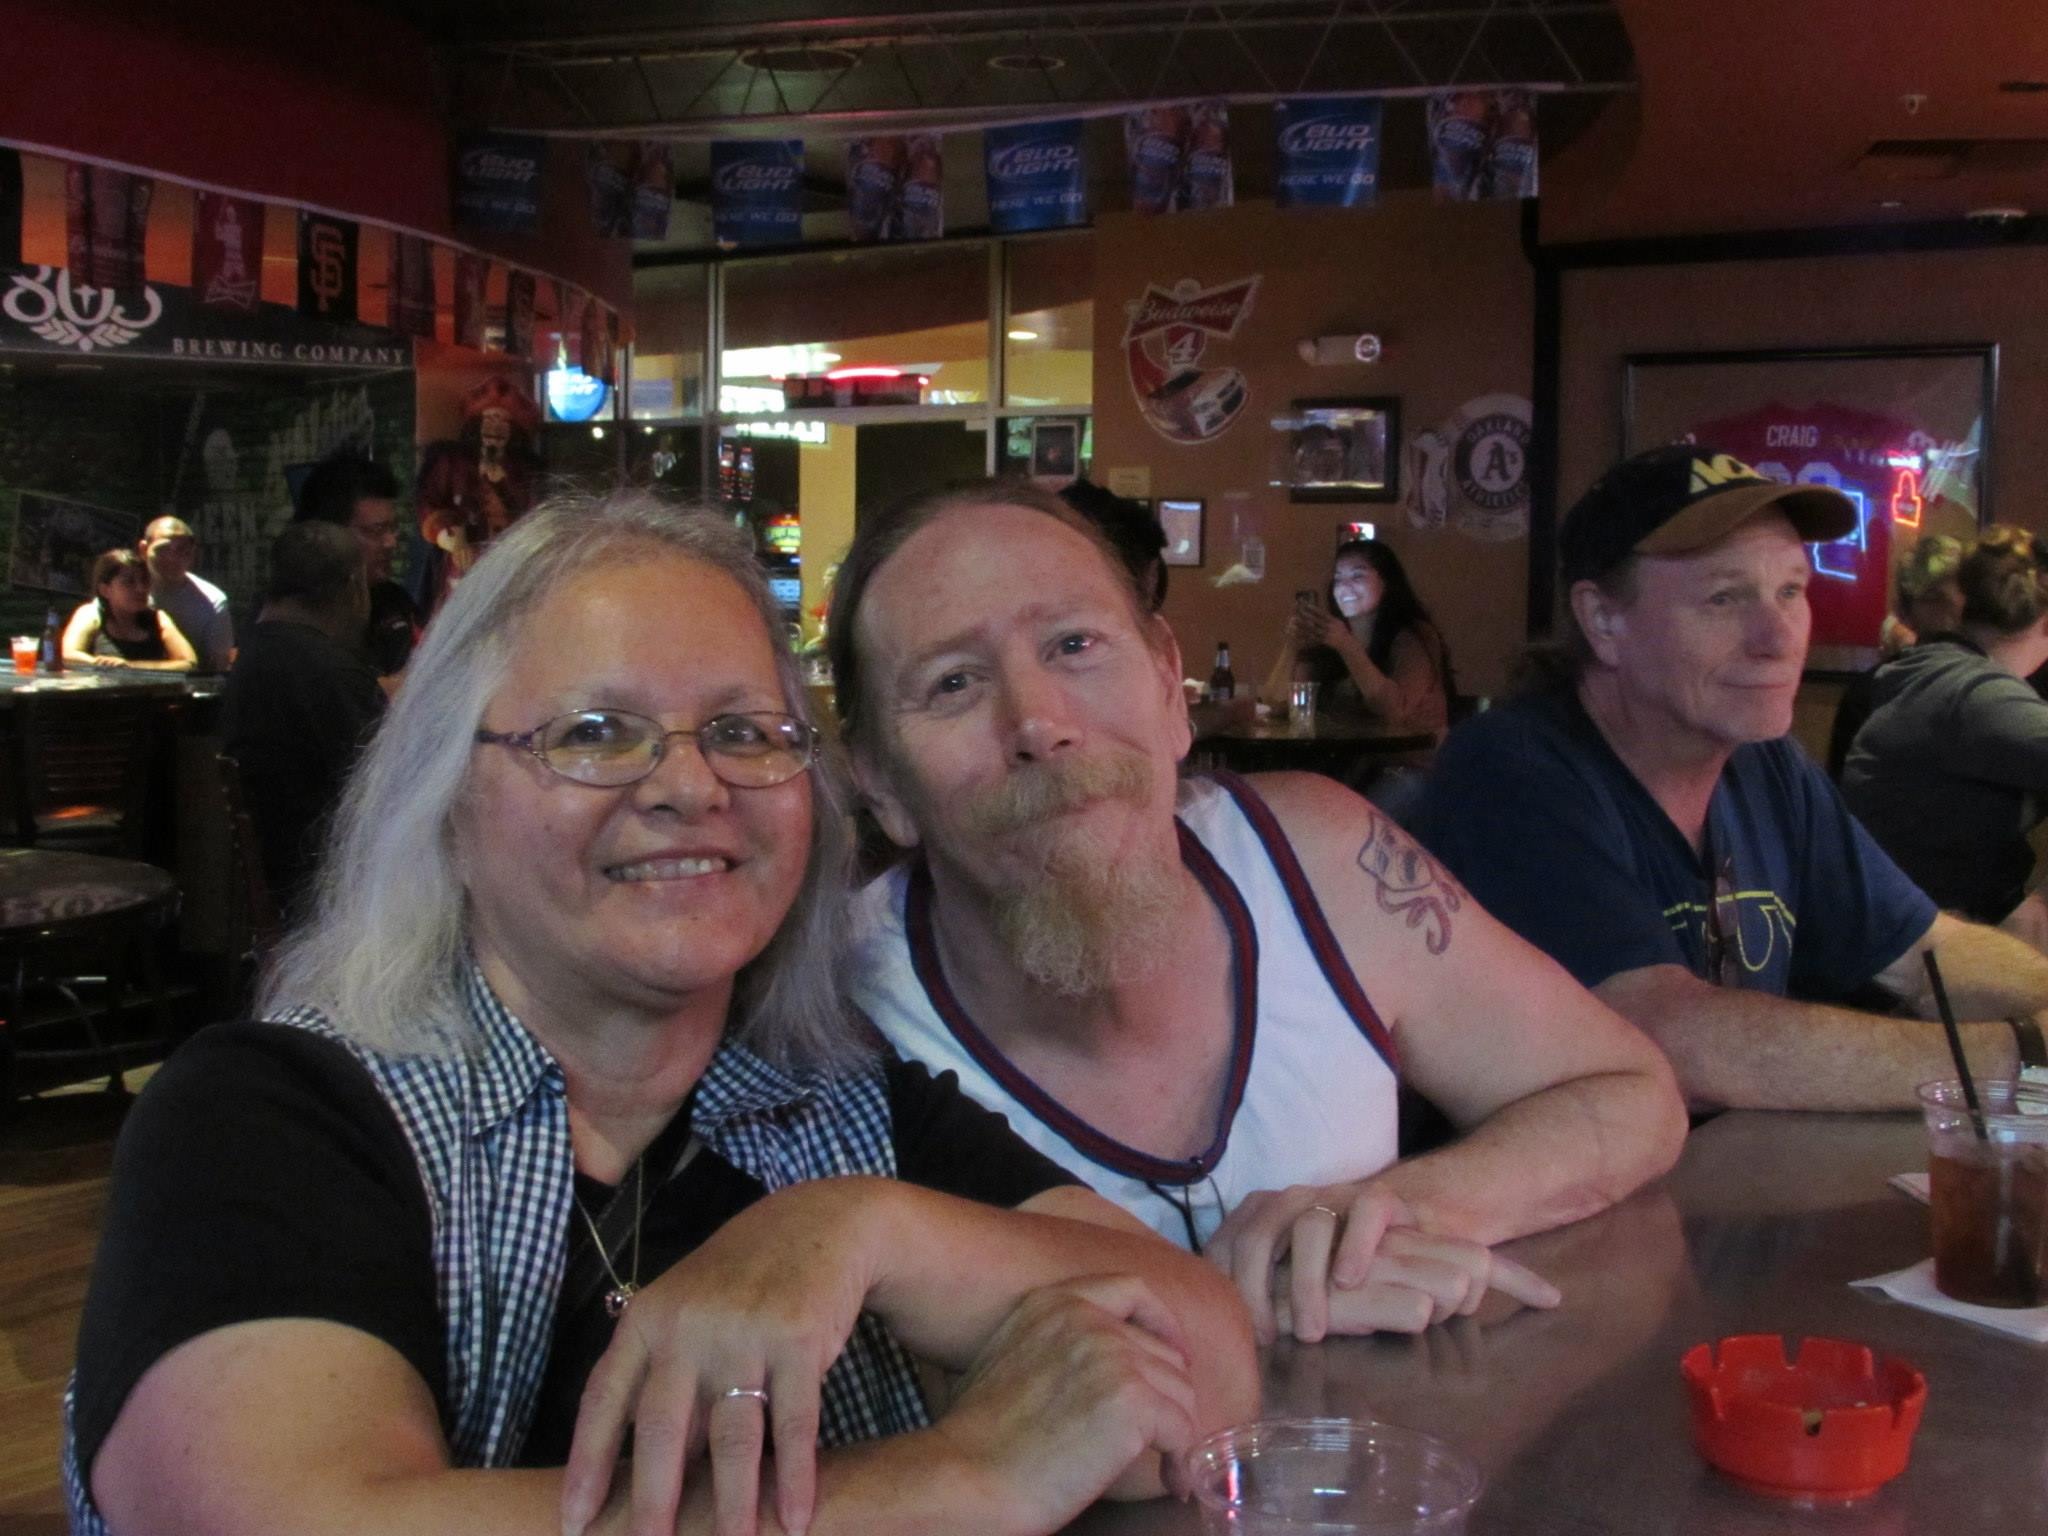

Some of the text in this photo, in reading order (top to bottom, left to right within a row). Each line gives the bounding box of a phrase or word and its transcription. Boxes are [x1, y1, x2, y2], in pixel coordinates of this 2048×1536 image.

[1305, 123, 1372, 139] BUD
[1288, 137, 1376, 151] LIGHT
[1013, 145, 1075, 160] BUD
[735, 164, 794, 179] BUD
[1002, 157, 1080, 176] LIGHT
[724, 177, 797, 191] LIGHT
[1321, 173, 1346, 186] WE
[1350, 173, 1376, 186] GO
[1059, 192, 1083, 204] GO
[172, 337, 404, 365] BREWING COMPANY
[1168, 332, 1196, 364] 4
[1766, 424, 1819, 448] CRAIG
